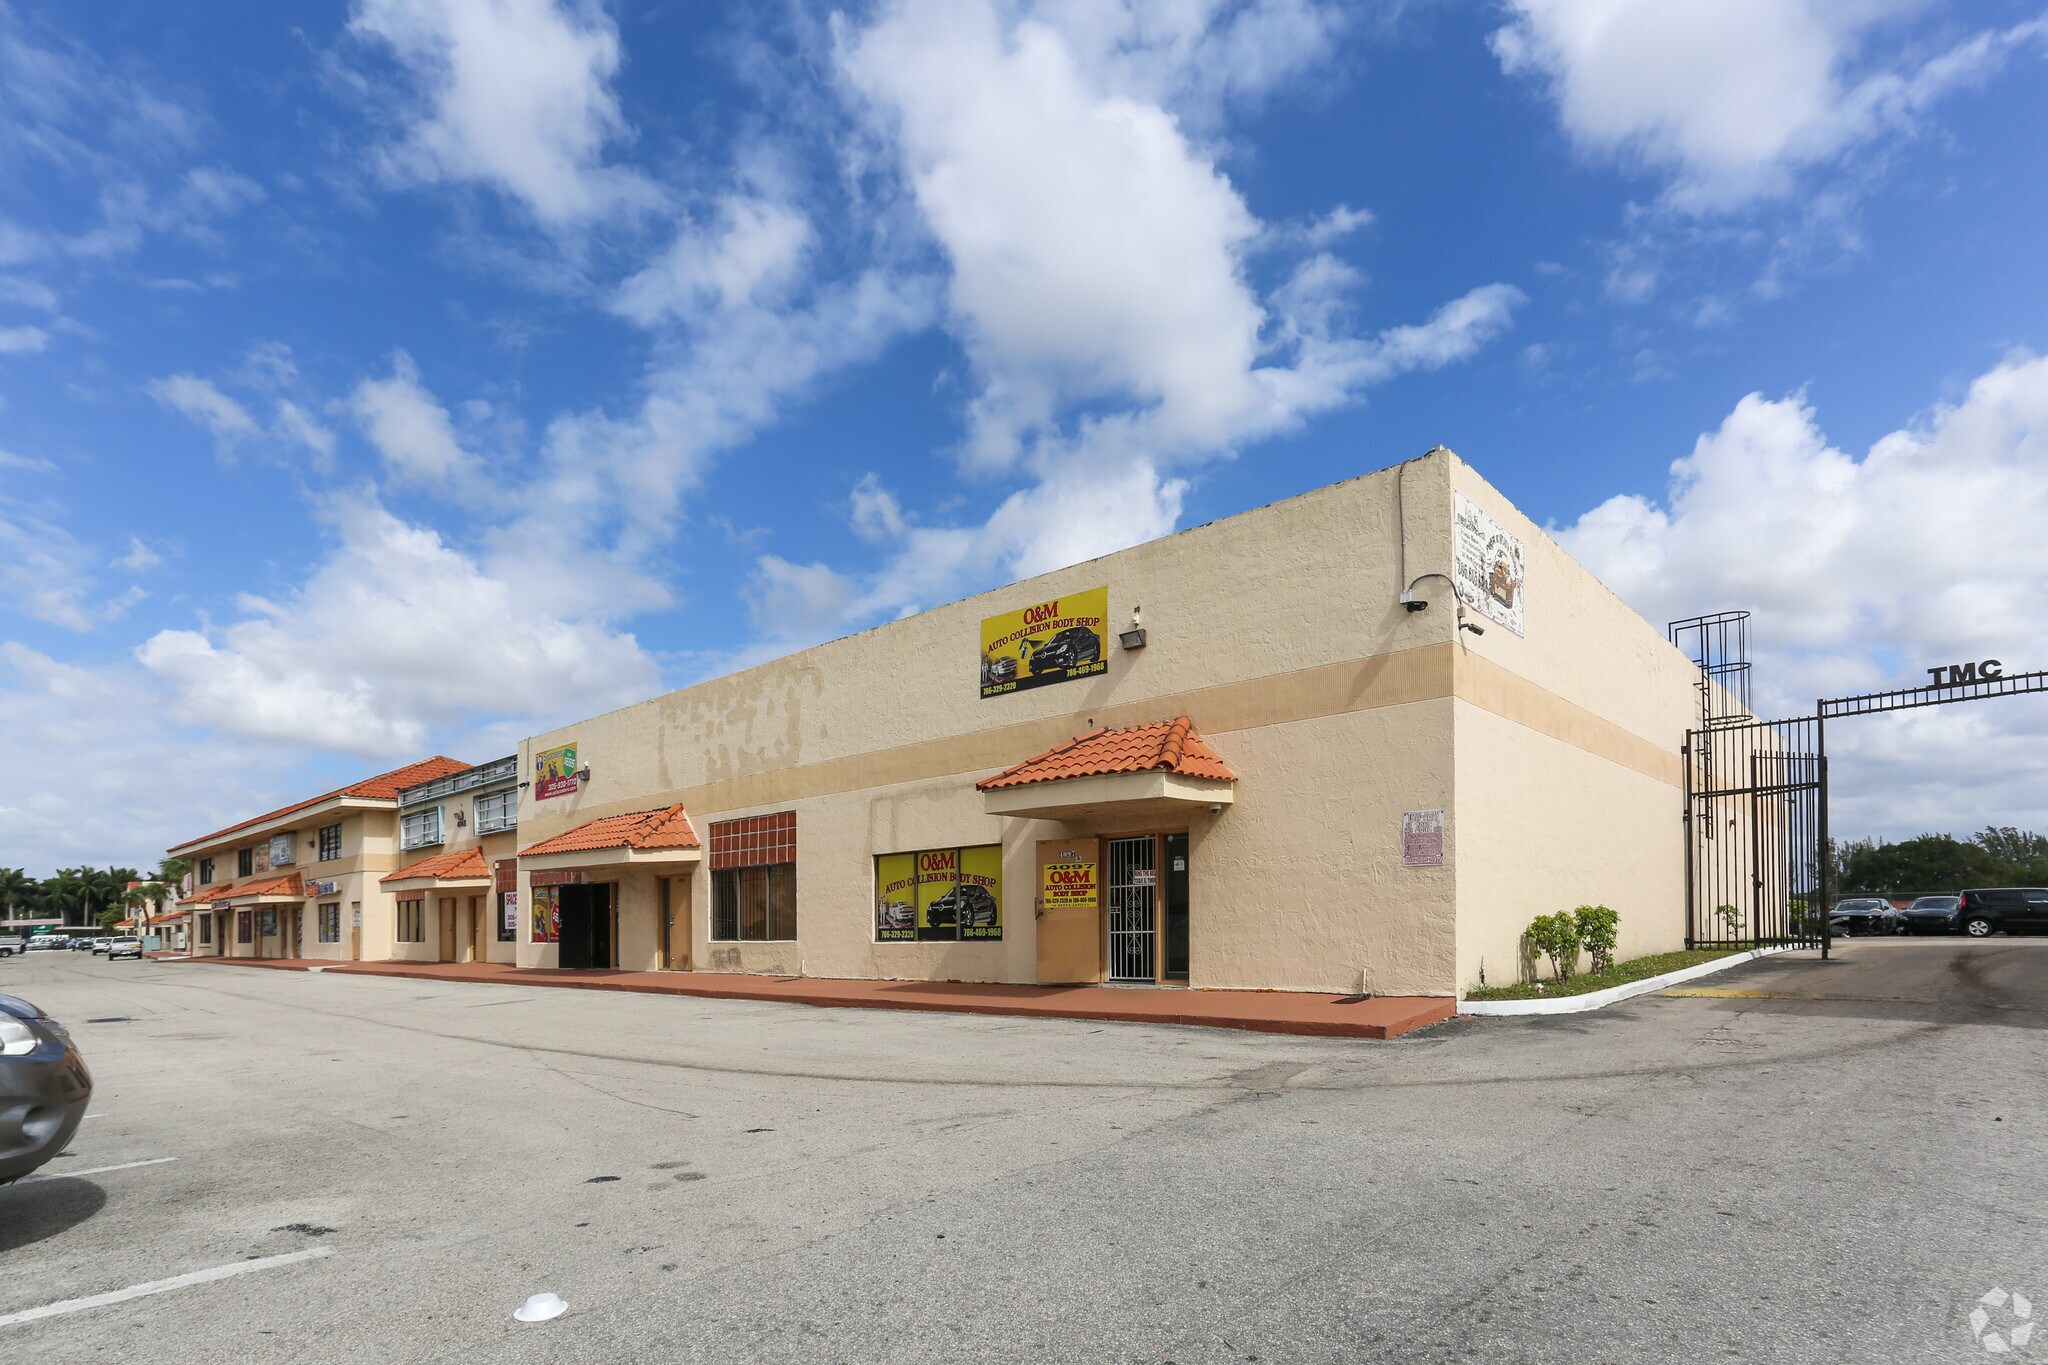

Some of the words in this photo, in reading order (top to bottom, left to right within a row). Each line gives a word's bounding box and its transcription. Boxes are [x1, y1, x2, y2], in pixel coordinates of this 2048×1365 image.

[1023, 601, 1058, 625] O&M
[988, 636, 1009, 653] AUTO
[1010, 622, 1051, 642] COLLISION
[1052, 617, 1075, 630] BODY
[1076, 617, 1100, 627] SHOP
[1066, 662, 1105, 677] 786-469-1968
[1927, 659, 2002, 687] TMC
[920, 851, 956, 871] O&M
[885, 880, 905, 894] AUTO
[973, 875, 996, 888] SHOP
[1050, 870, 1091, 884] O&M
